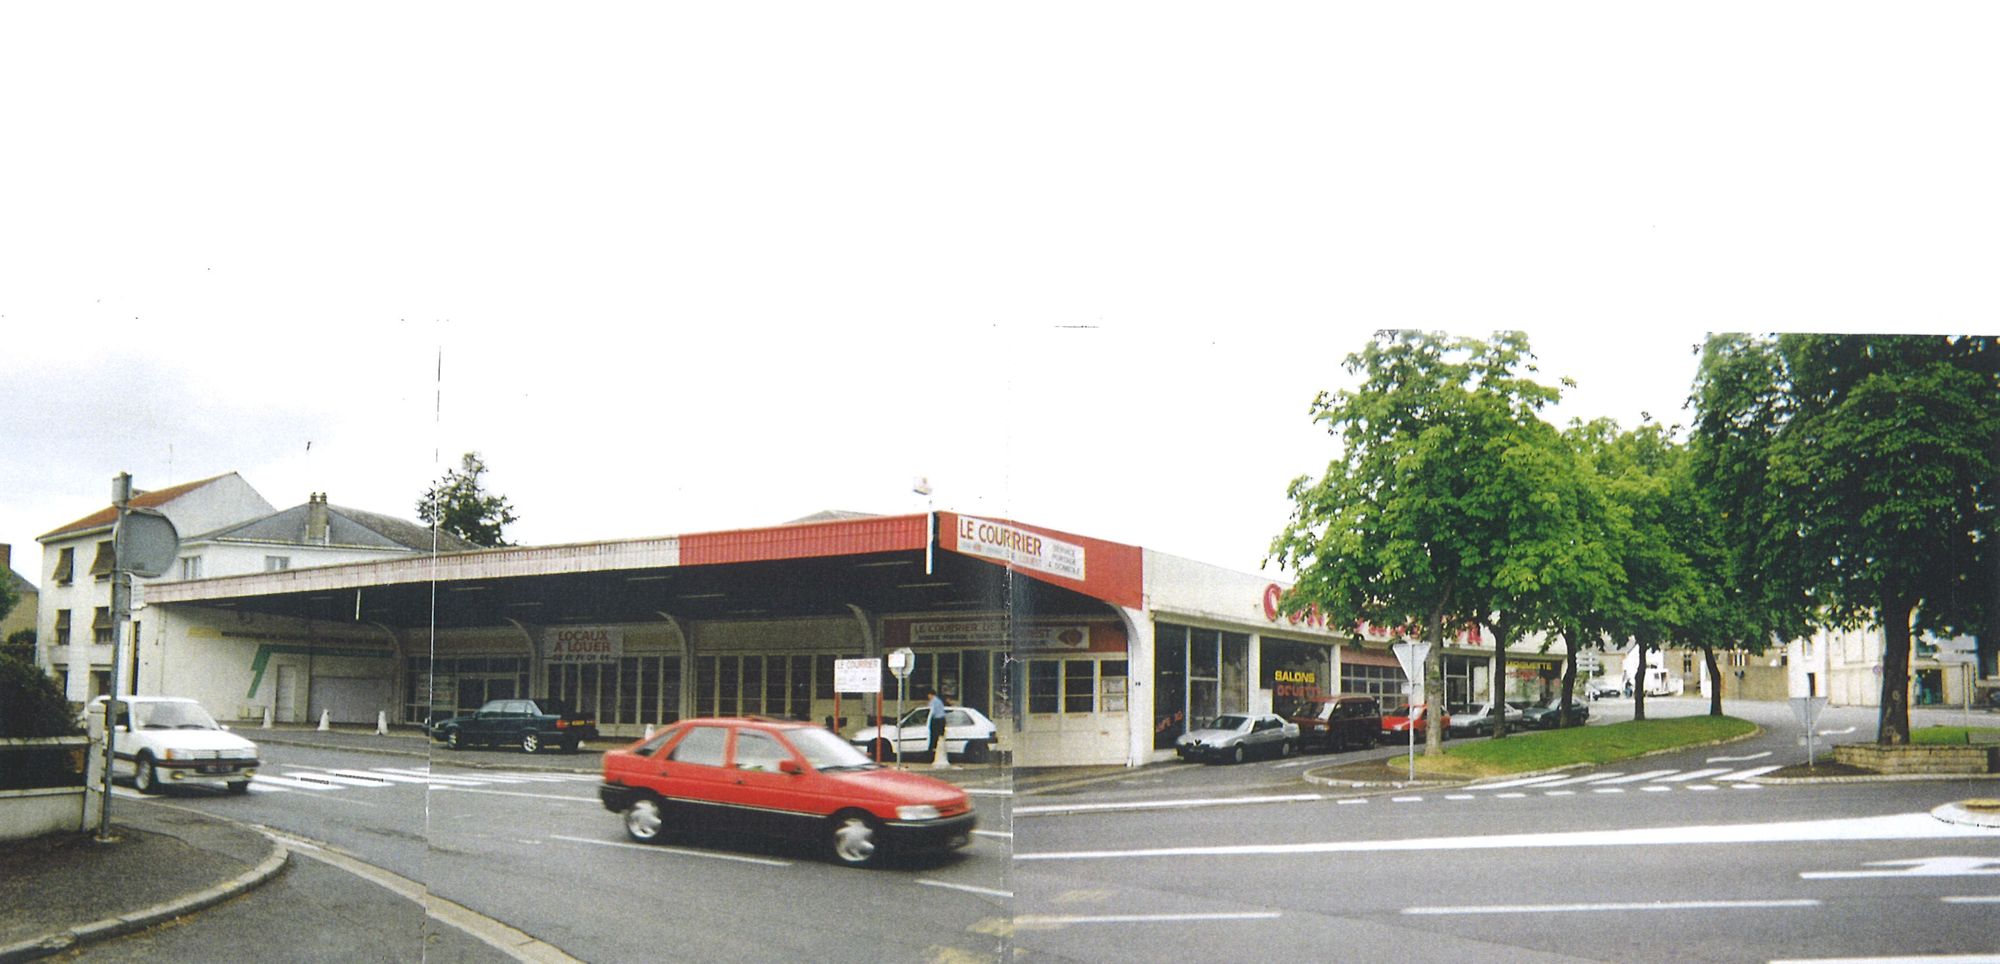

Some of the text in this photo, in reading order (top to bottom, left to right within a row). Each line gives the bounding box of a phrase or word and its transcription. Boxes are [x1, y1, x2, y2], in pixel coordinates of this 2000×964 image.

[960, 519, 974, 540] LE
[978, 524, 1042, 557] COURRIER
[558, 630, 608, 641] LOCAUX
[554, 641, 611, 653] A LOUER
[1274, 669, 1316, 683] SALONS
